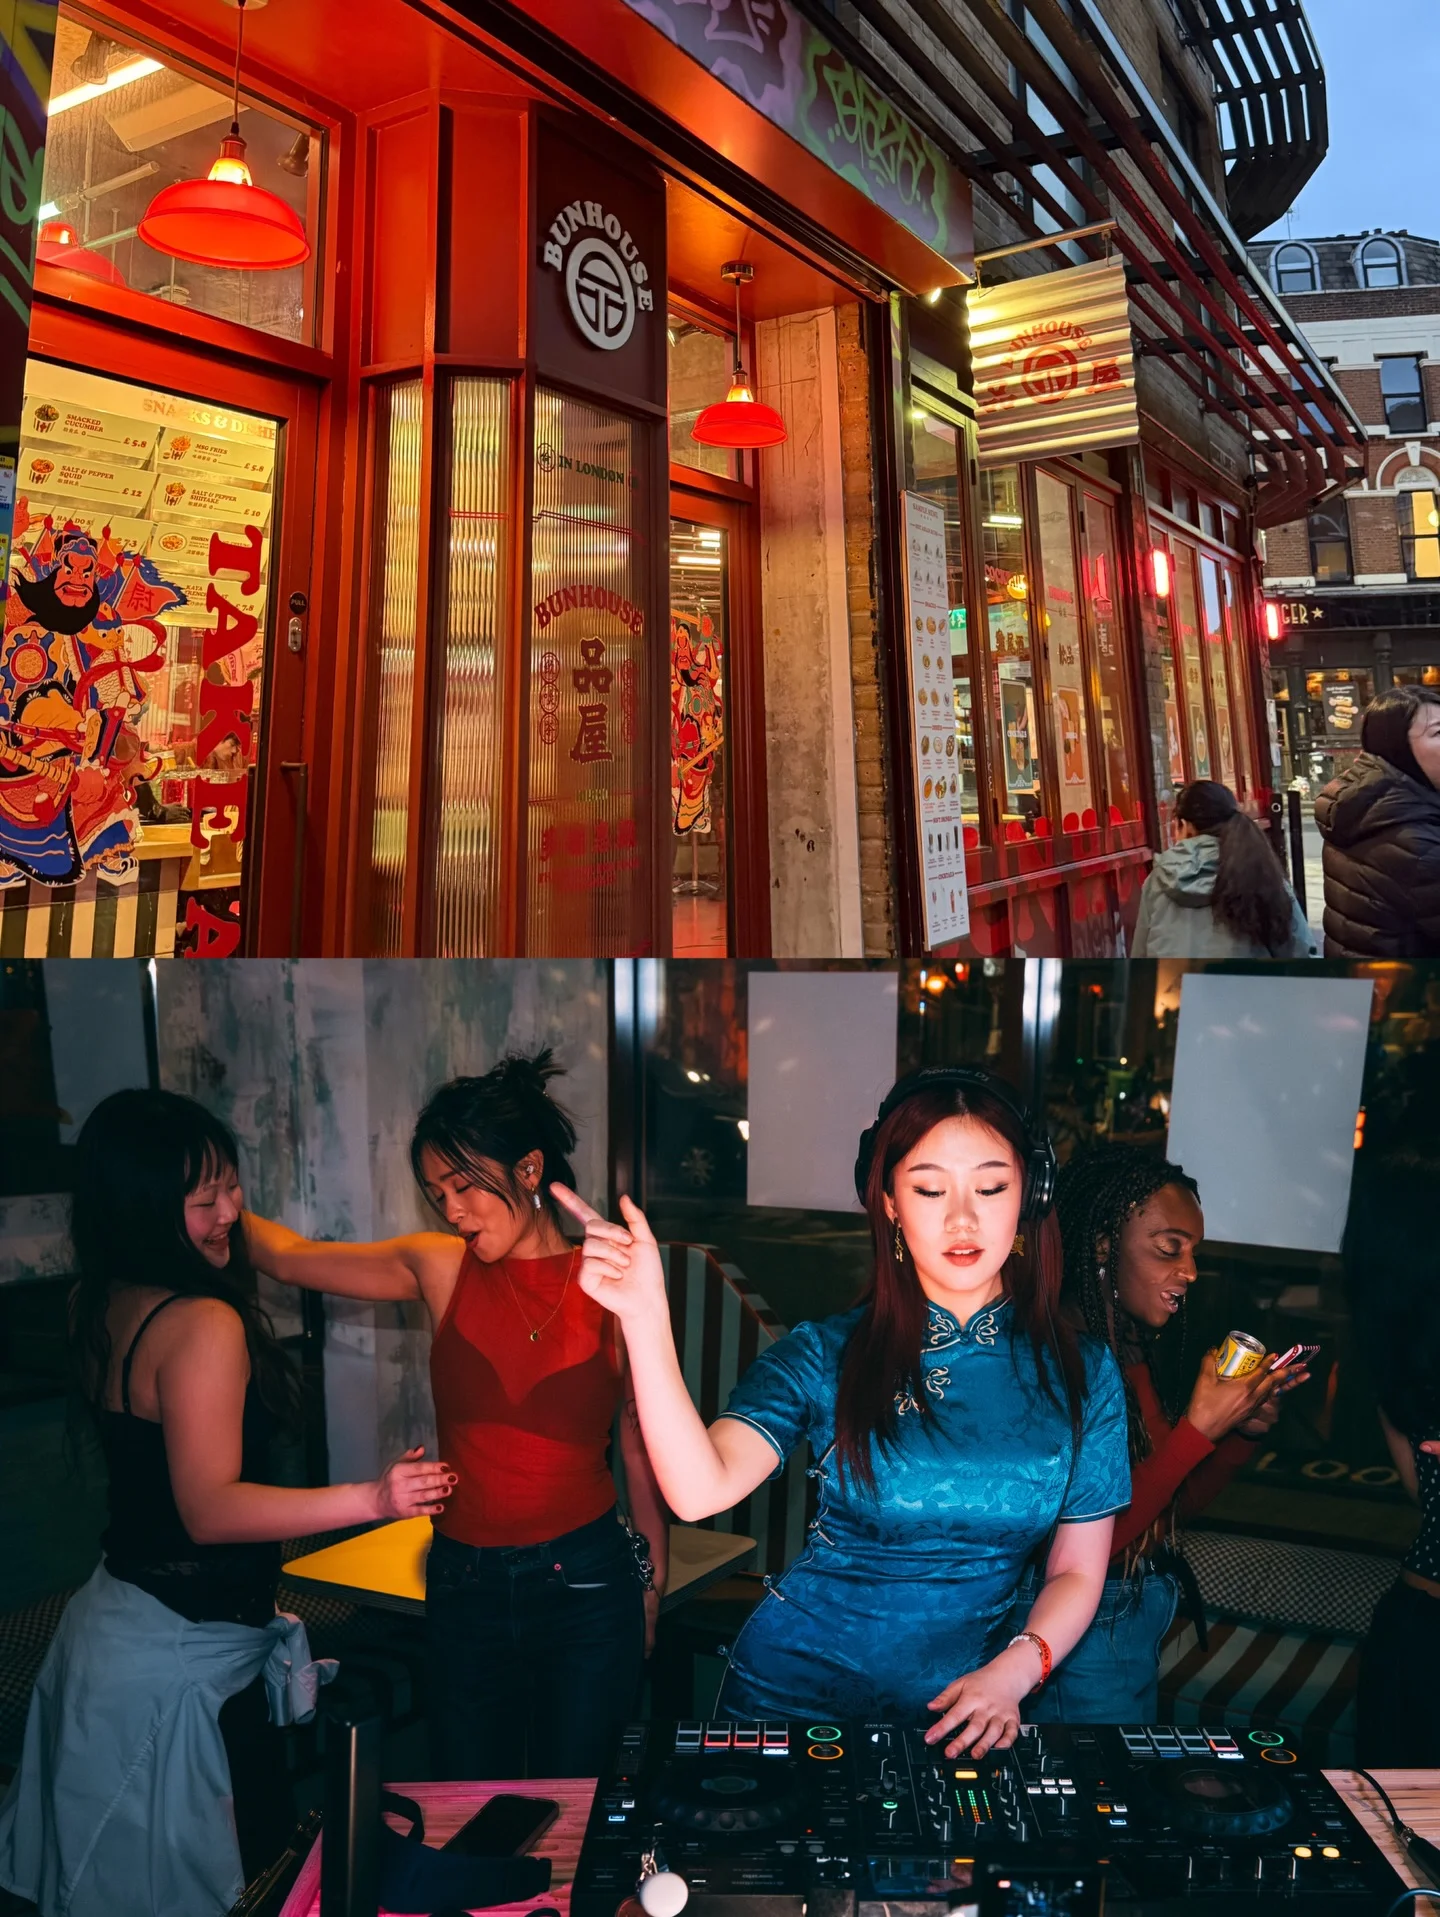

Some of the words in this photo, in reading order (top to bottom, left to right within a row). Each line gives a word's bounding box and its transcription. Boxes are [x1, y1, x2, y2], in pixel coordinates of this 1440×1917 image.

[544, 200, 653, 311] BUNHOUSE
[66, 413, 102, 426] SMACKED
[143, 399, 209, 425] SNAKS
[214, 415, 228, 429] &
[64, 419, 104, 432] CUCUMBER
[195, 443, 209, 451] MSG
[209, 446, 228, 455] FRIES
[59, 471, 82, 480] SQUID
[61, 465, 80, 473] SALT
[88, 470, 114, 480] PEPPER
[558, 455, 573, 470] IN
[576, 461, 625, 484] LONDON
[191, 489, 208, 497] SALT
[214, 493, 237, 502] PEPPER
[534, 584, 644, 636] BUNHOUSE
[918, 1068, 972, 1078] Pioneer
